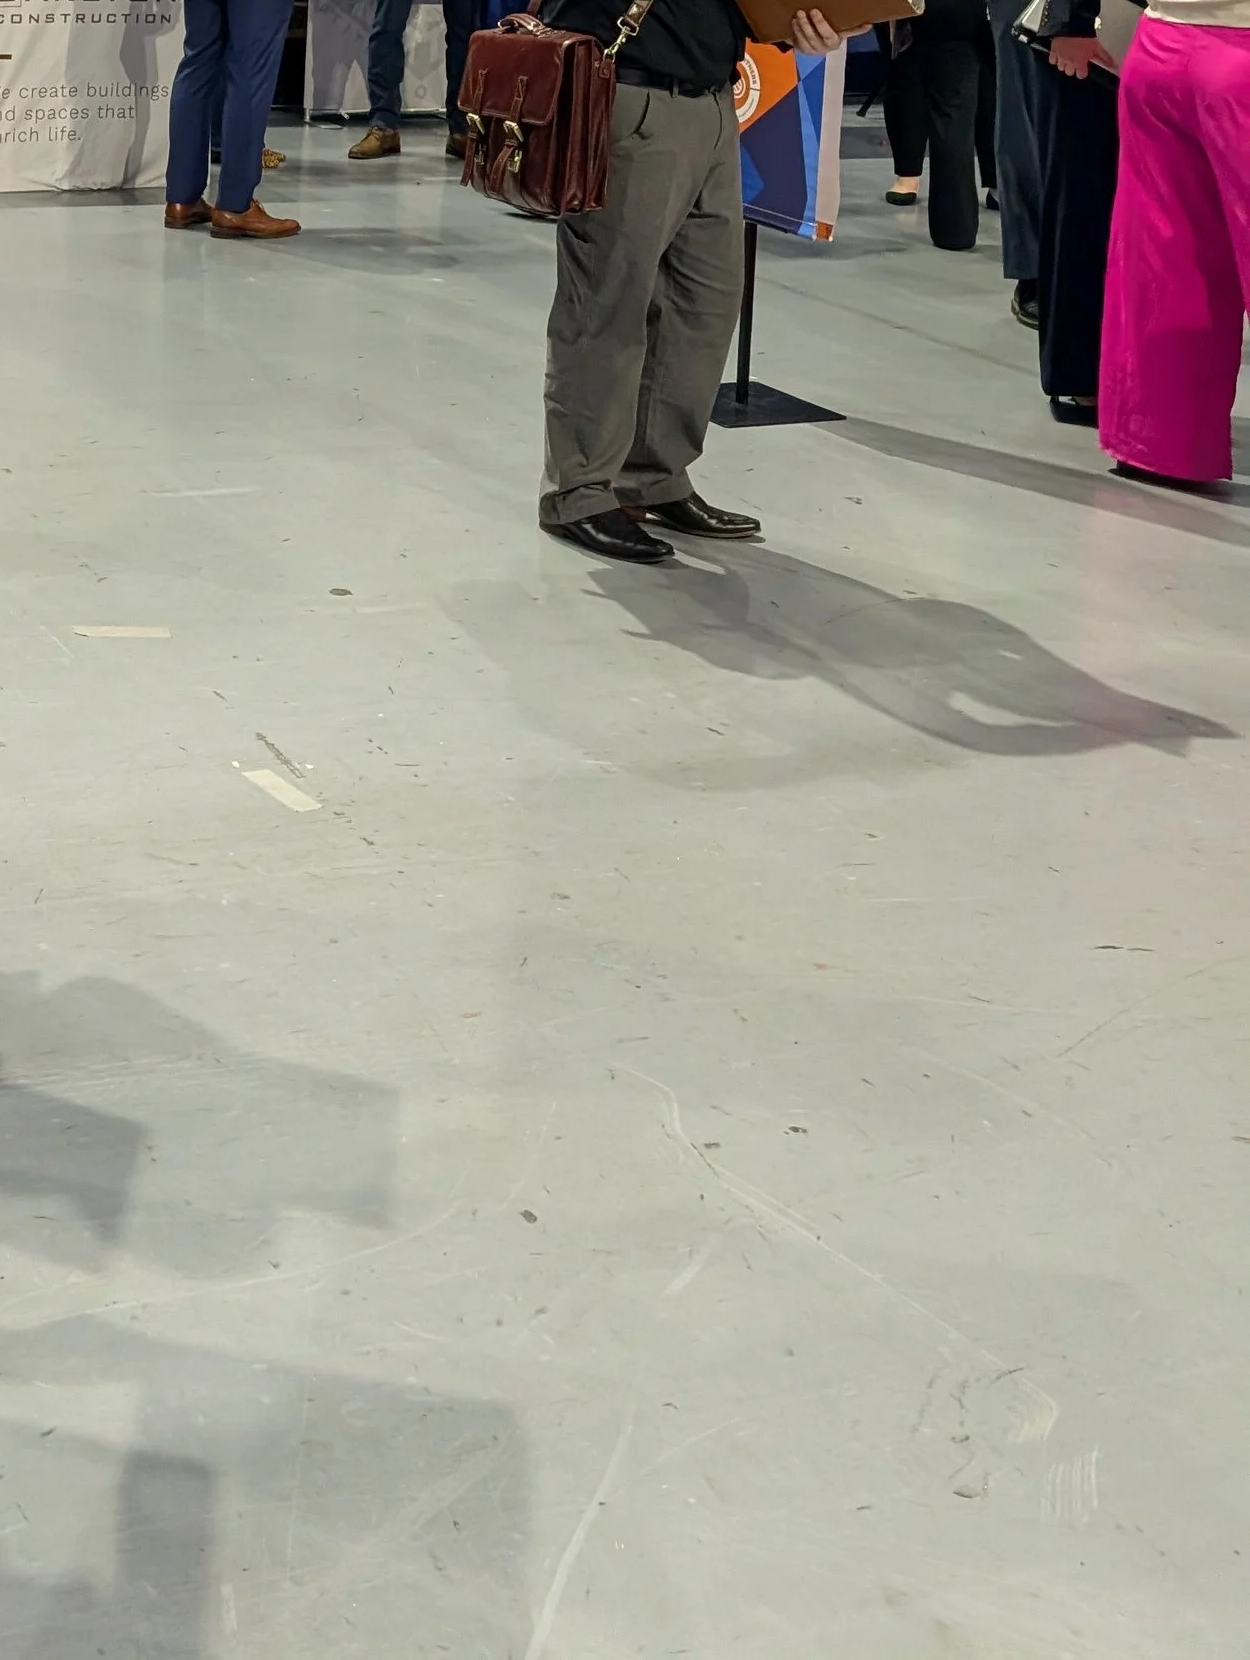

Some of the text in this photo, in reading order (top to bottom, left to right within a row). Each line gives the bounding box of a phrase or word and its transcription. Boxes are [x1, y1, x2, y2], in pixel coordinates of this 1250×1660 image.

[19, 84, 78, 99] create
[87, 82, 169, 101] buildings
[24, 107, 89, 123] spaces
[97, 104, 135, 119] that
[48, 126, 82, 141] life.
